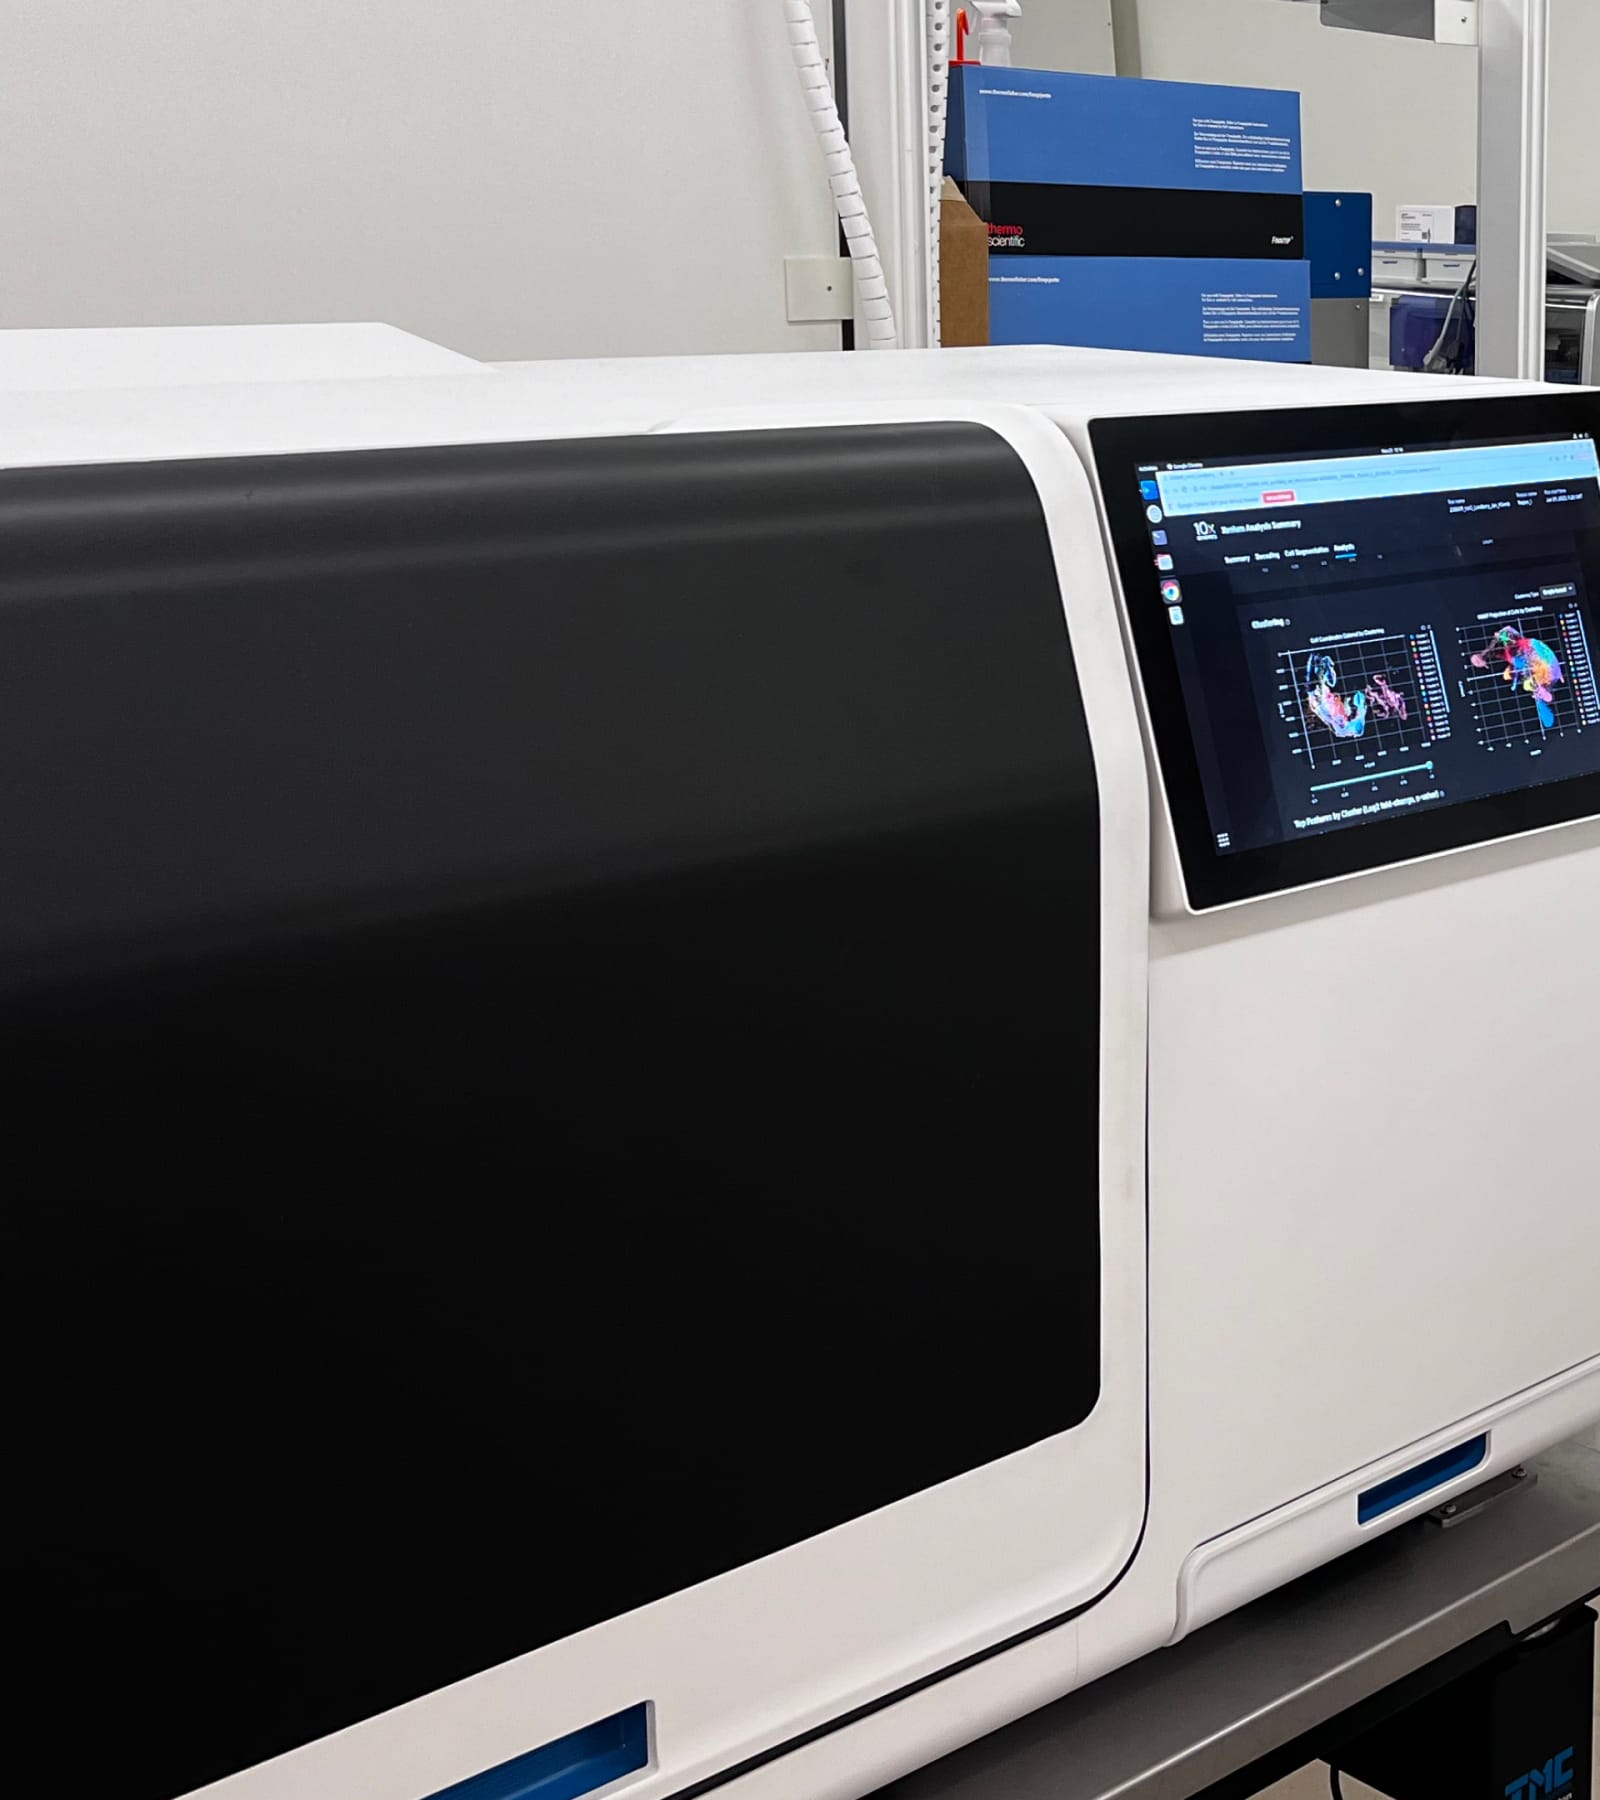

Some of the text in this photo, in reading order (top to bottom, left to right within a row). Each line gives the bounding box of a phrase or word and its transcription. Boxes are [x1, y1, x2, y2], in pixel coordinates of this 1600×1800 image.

[988, 223, 1024, 235] thermo
[988, 236, 1025, 247] scientific
[1193, 521, 1216, 536] 10x
[1251, 618, 1284, 630] Clustering
[1293, 819, 1306, 829] Top
[1306, 814, 1333, 826] Features
[1332, 811, 1341, 821] by
[1341, 807, 1362, 818] Cluster
[1505, 1745, 1574, 1800] TMC
